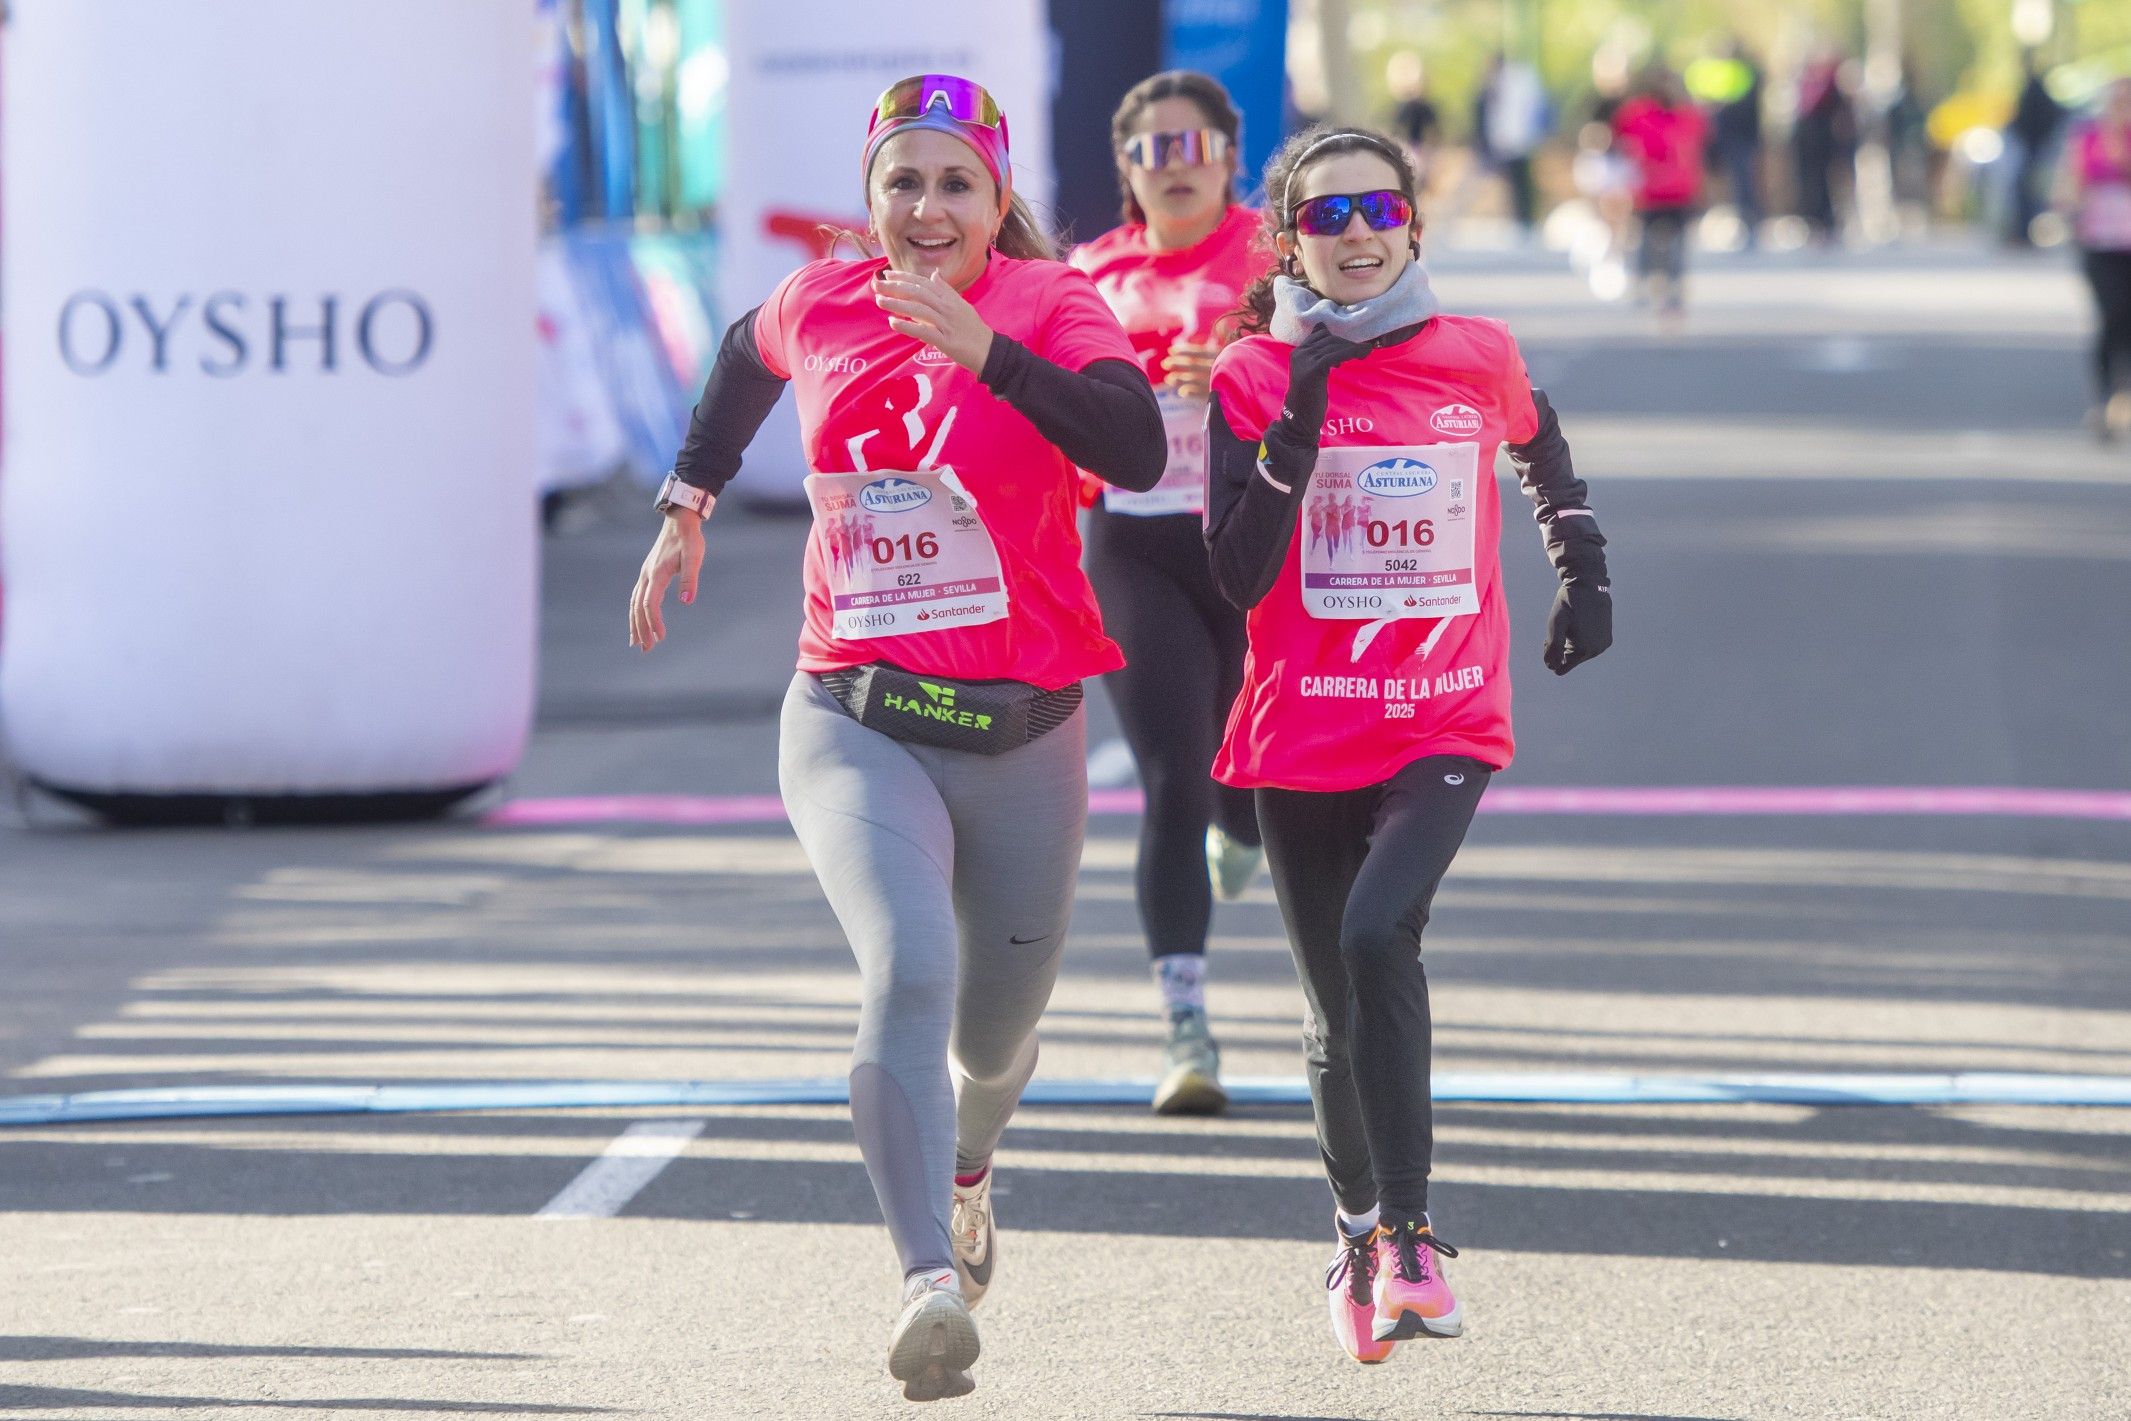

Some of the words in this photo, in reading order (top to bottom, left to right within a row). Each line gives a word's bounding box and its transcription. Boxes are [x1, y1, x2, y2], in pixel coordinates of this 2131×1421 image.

[56, 286, 436, 379] OYSHO
[804, 354, 866, 375] OYSHO
[1320, 417, 1374, 437] SHO
[1316, 479, 1352, 489] SUMA
[1363, 472, 1433, 488] ASTURIANA
[825, 498, 857, 512] SUMA
[865, 490, 928, 506] ASTURIANA
[1366, 519, 1434, 547] 016
[872, 531, 939, 564] 016
[1385, 559, 1417, 571] 5042
[897, 573, 921, 587] 622
[1329, 577, 1368, 586] CARRERA
[1371, 577, 1381, 586] DE
[1384, 577, 1394, 585] LA
[1397, 575, 1426, 585] MUJER
[1433, 573, 1456, 584] SEVILLA
[850, 595, 880, 606] CARRERA
[882, 594, 893, 603] DE
[895, 593, 905, 601] LA
[908, 588, 936, 600] MUJER
[943, 583, 977, 595] SEVILLA
[1323, 595, 1382, 609] OYSHO
[1419, 593, 1462, 608] Santander
[932, 604, 986, 620] Santander
[848, 612, 895, 629] OYSHO
[1300, 675, 1378, 699] CARRERA
[1384, 678, 1406, 699] DE
[1410, 677, 1431, 700] LA
[1434, 665, 1485, 697] MUJER
[884, 692, 992, 730] HANKER
[1384, 702, 1415, 719] 2025
